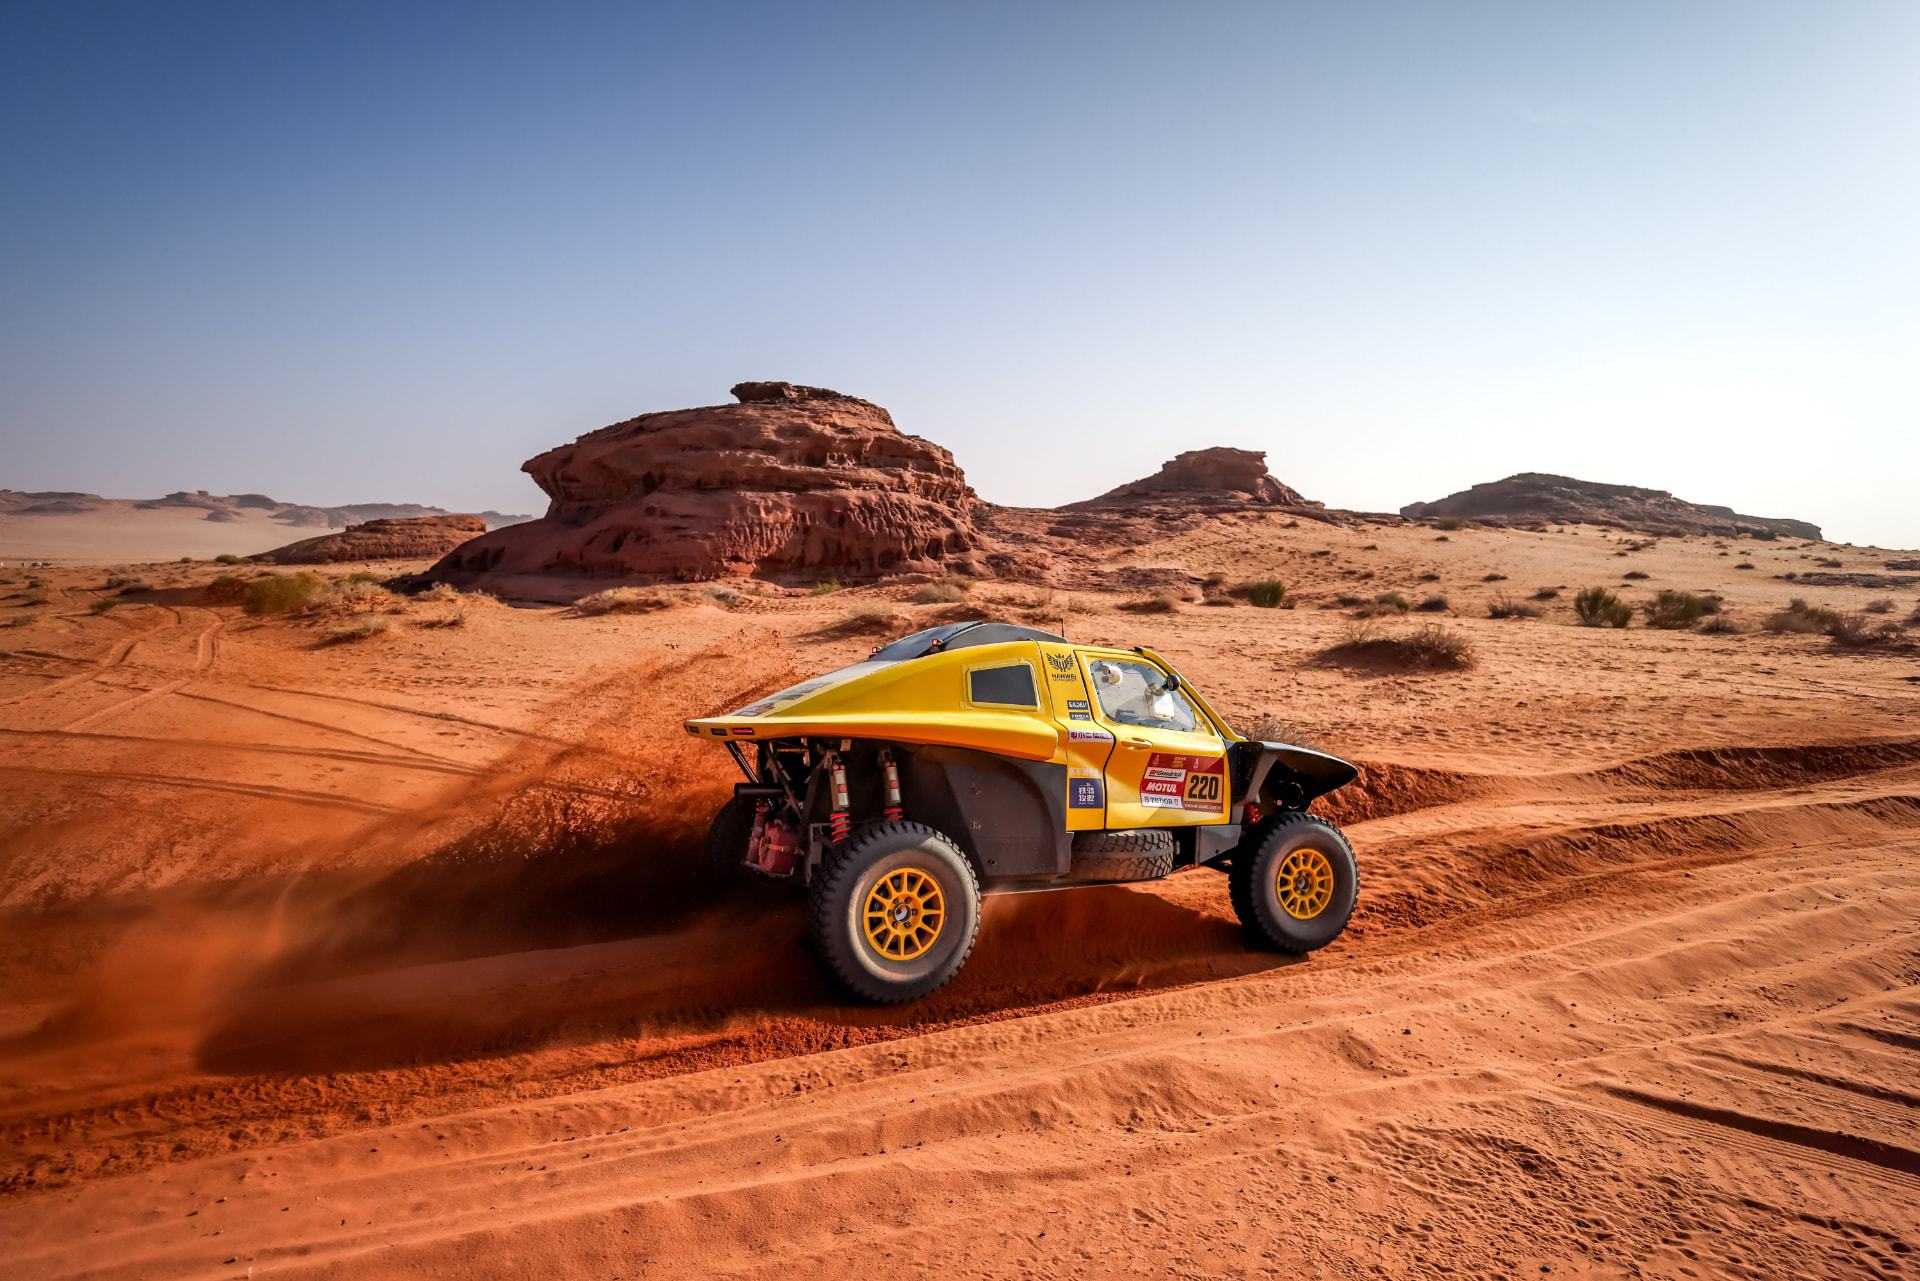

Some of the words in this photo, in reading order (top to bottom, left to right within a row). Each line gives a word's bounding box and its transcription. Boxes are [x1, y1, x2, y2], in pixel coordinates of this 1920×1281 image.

[1052, 673, 1076, 681] HANWEI
[1149, 769, 1182, 778] BFGoodrich
[1145, 782, 1177, 793] MOTUL
[1188, 774, 1219, 801] 220
